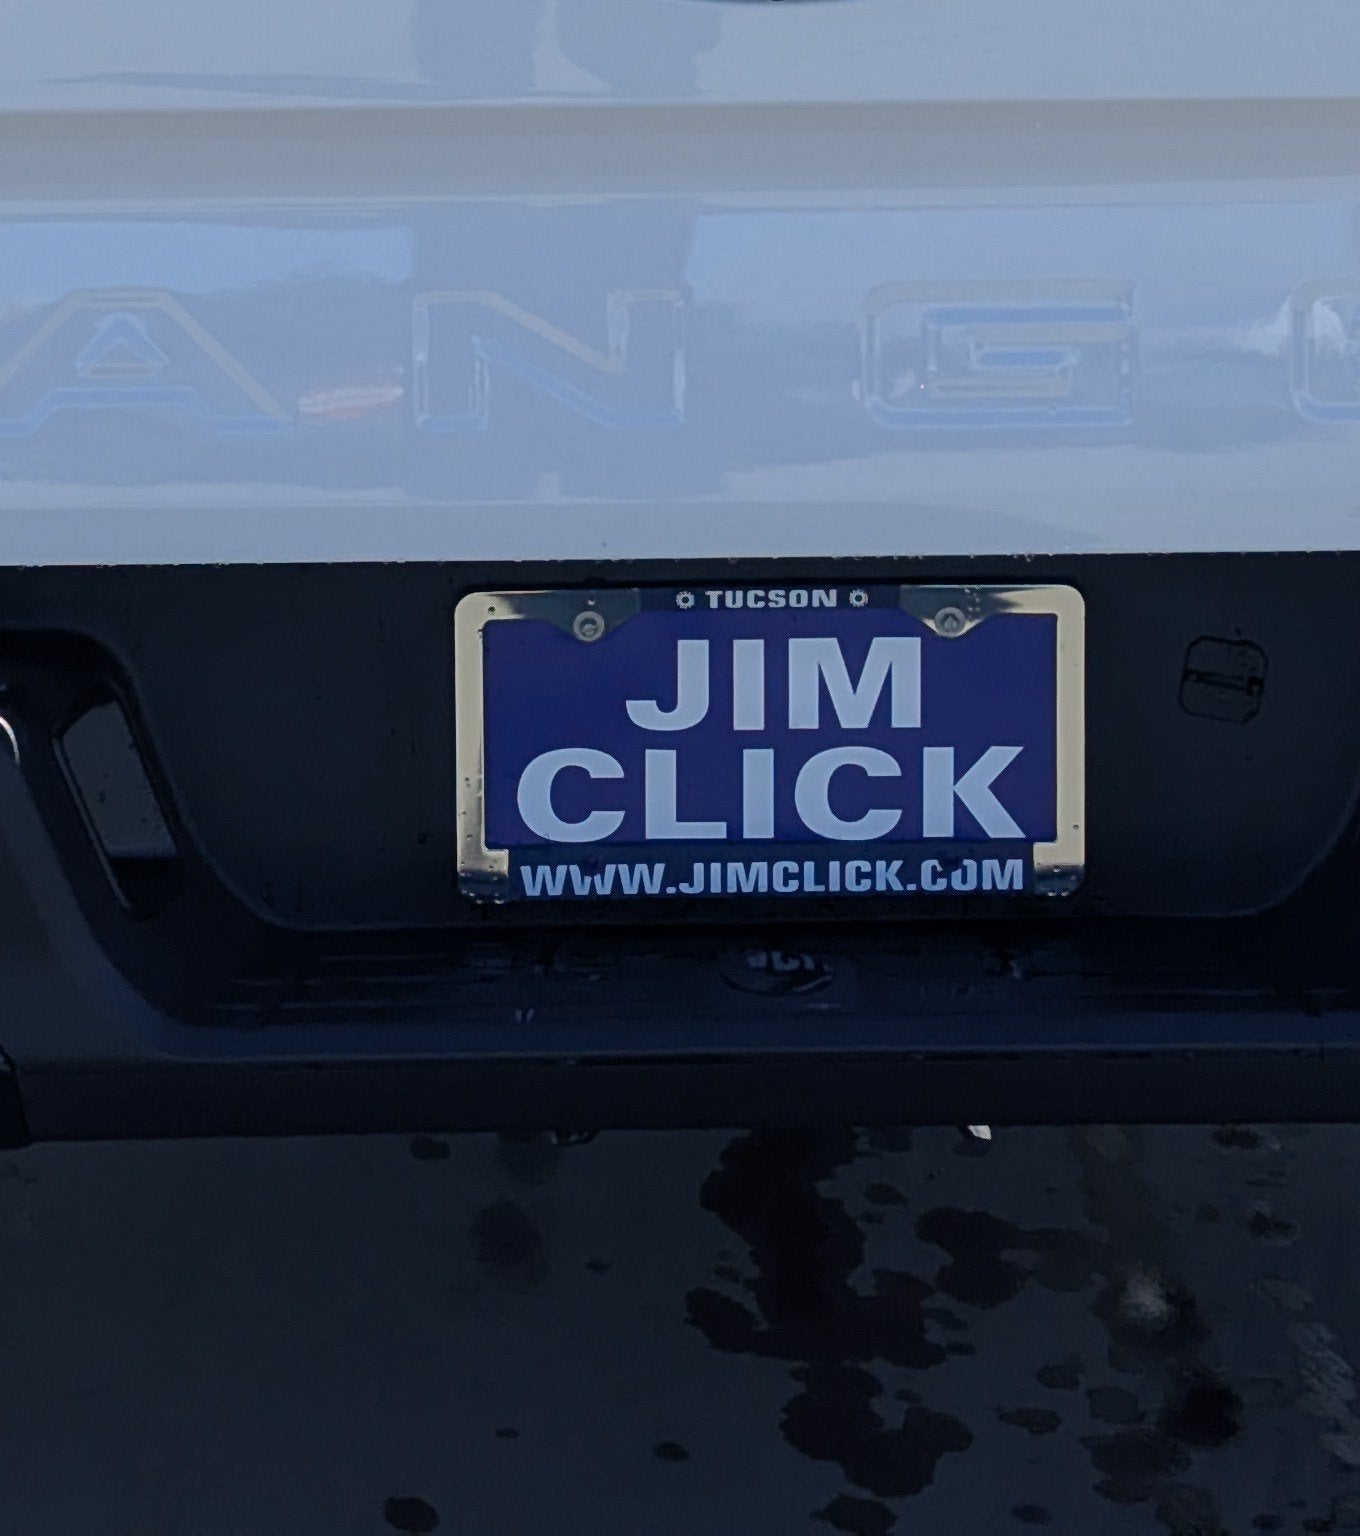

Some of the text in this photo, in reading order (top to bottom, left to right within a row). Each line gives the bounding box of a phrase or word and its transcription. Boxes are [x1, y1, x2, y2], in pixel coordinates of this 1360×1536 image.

[705, 588, 838, 609] TUCSON
[625, 636, 922, 731] JIM
[516, 746, 1026, 843] CLICK
[519, 859, 1024, 898] WWW.JIMCLICK.COM
